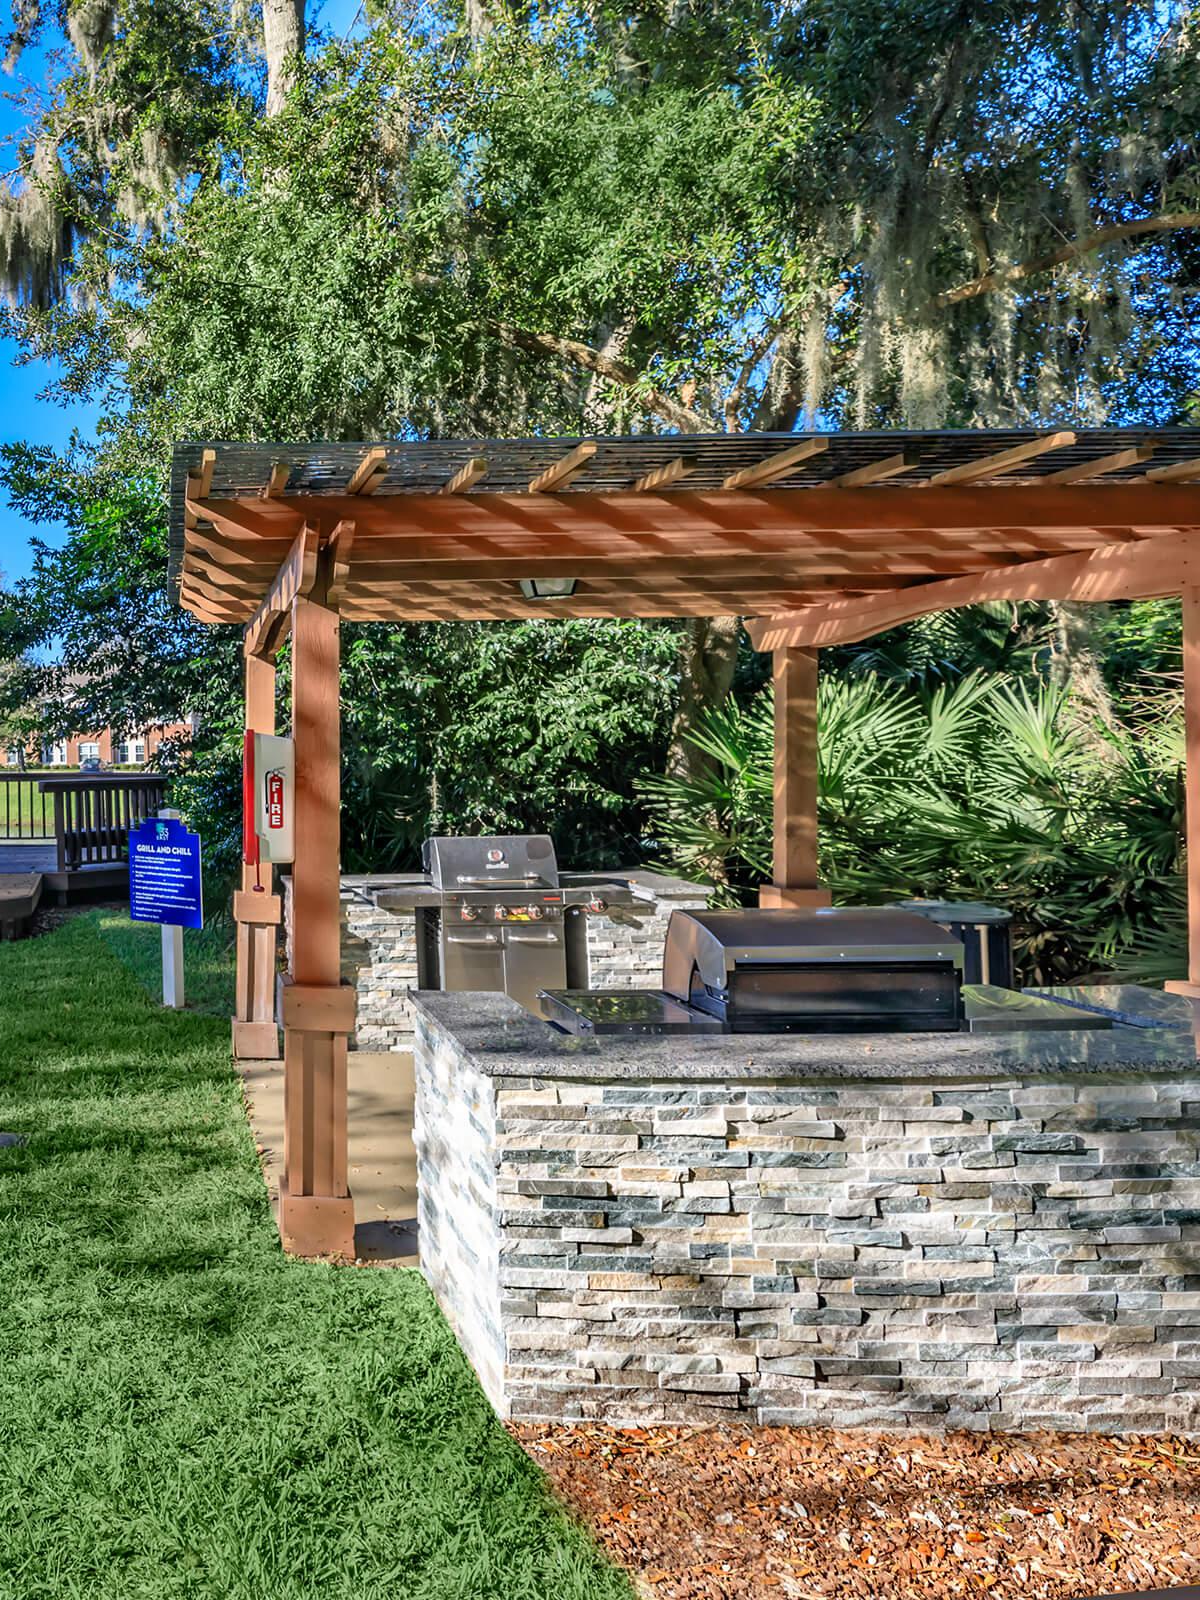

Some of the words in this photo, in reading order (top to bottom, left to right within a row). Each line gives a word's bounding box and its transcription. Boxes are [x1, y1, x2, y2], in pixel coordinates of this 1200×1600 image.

[271, 781, 281, 825] FIRE
[136, 844, 156, 853] GRILL
[156, 846, 171, 854] AND
[171, 847, 192, 856] CHILL
